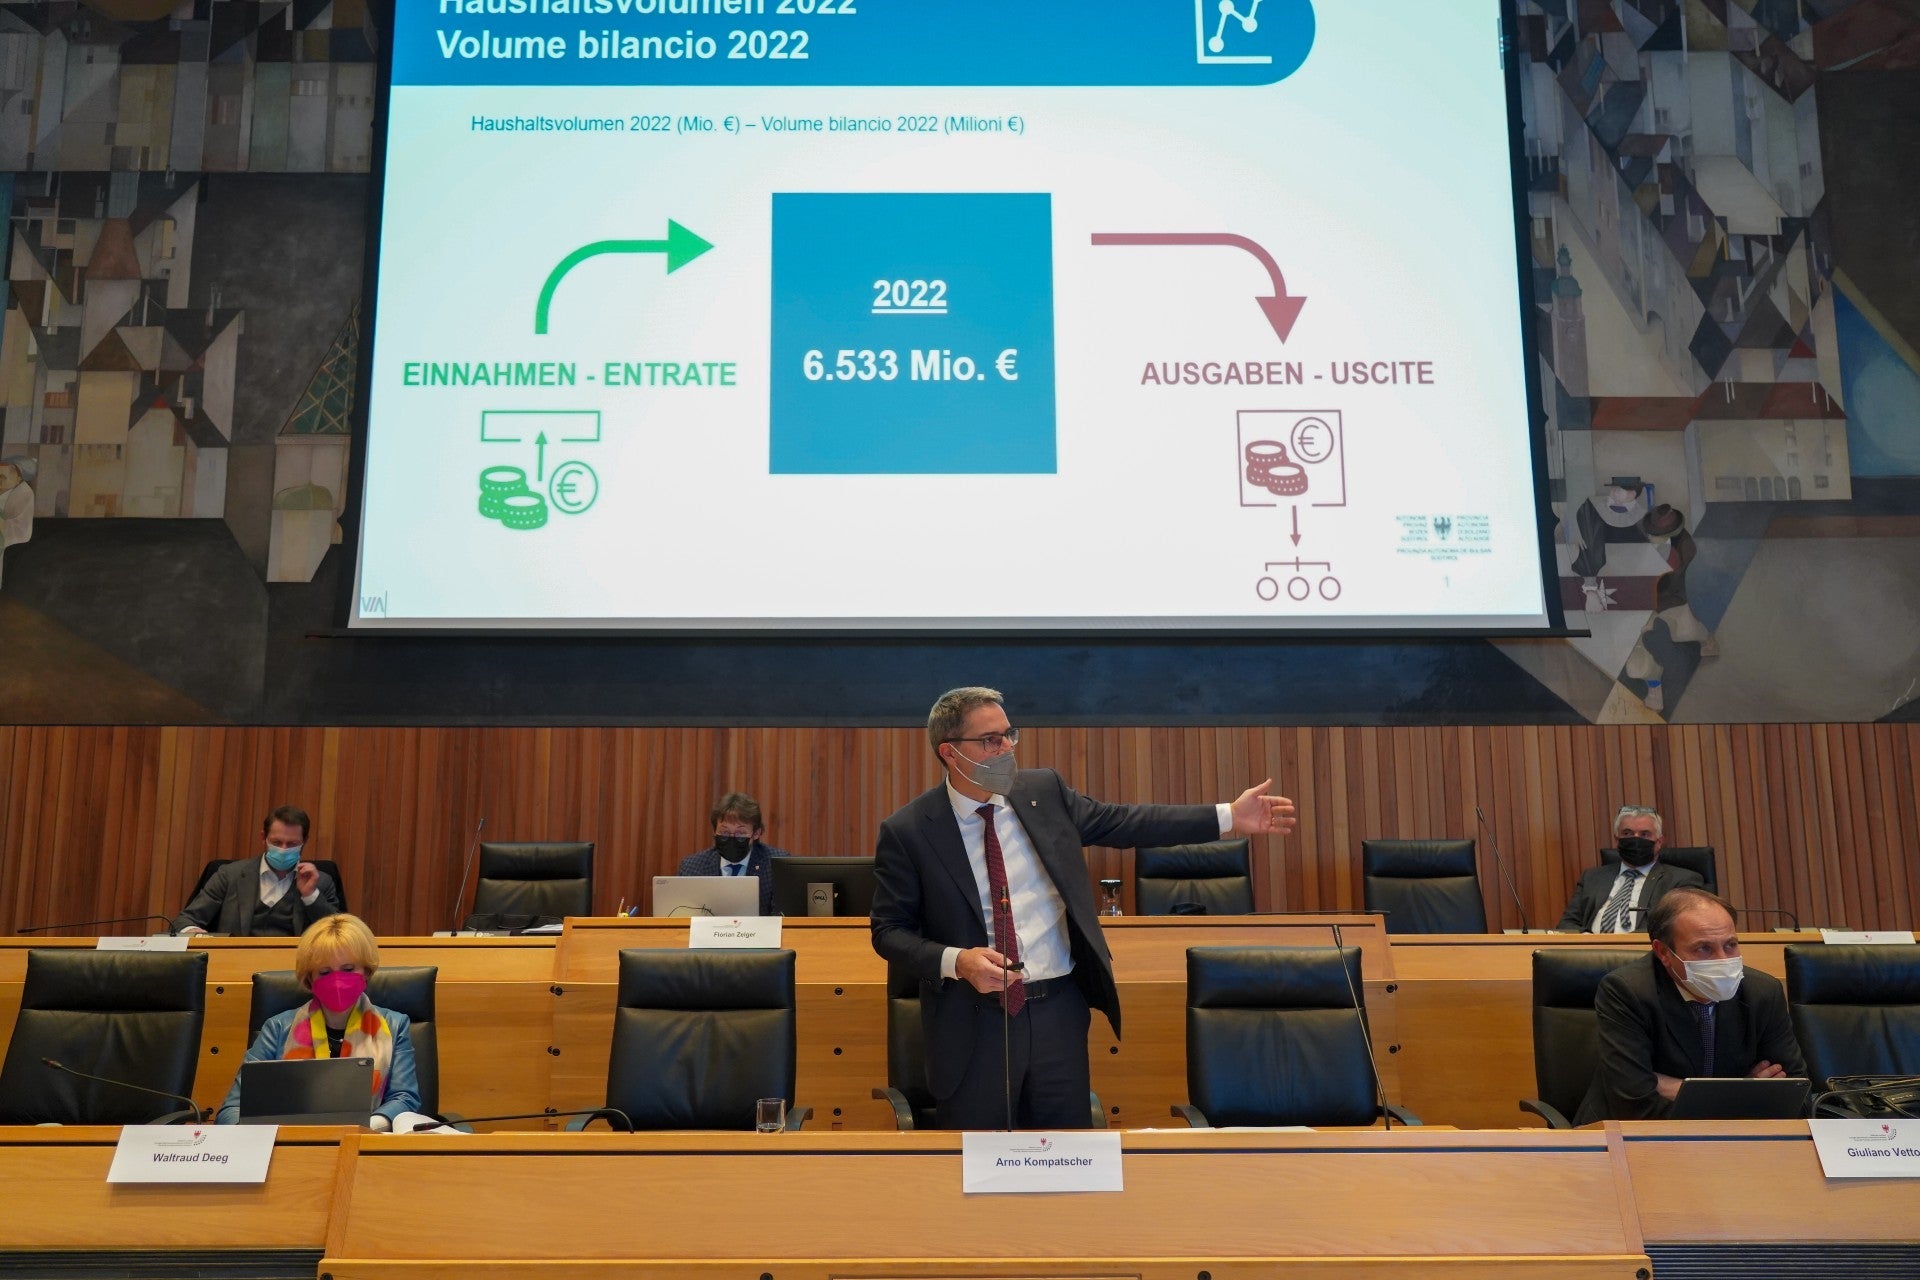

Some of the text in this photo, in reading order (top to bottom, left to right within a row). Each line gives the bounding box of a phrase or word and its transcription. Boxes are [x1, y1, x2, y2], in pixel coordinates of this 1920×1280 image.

[436, 30, 809, 59] Volume bilancio 2022
[471, 116, 624, 131] Haushaltsvolumen
[630, 116, 671, 131] 2022
[677, 115, 717, 135] (Mio.
[723, 115, 741, 135] €)
[761, 116, 823, 131] Volume
[829, 116, 892, 131] bilancio
[897, 116, 938, 131] 2022
[944, 115, 1002, 135] (Milioni
[1008, 115, 1025, 135] €)
[872, 279, 948, 314] 2022
[402, 362, 577, 386] EINNAHMEN
[603, 362, 737, 386] ENTRATE
[803, 348, 1019, 381] 6.533 Mio. €
[1140, 361, 1304, 385] AUSGABEN
[1331, 361, 1434, 384] USCITE
[153, 1153, 229, 1164] Waltraud Deeg
[996, 1157, 1092, 1168] Arno Kompatscher
[1847, 1147, 1891, 1157] Giuliano
